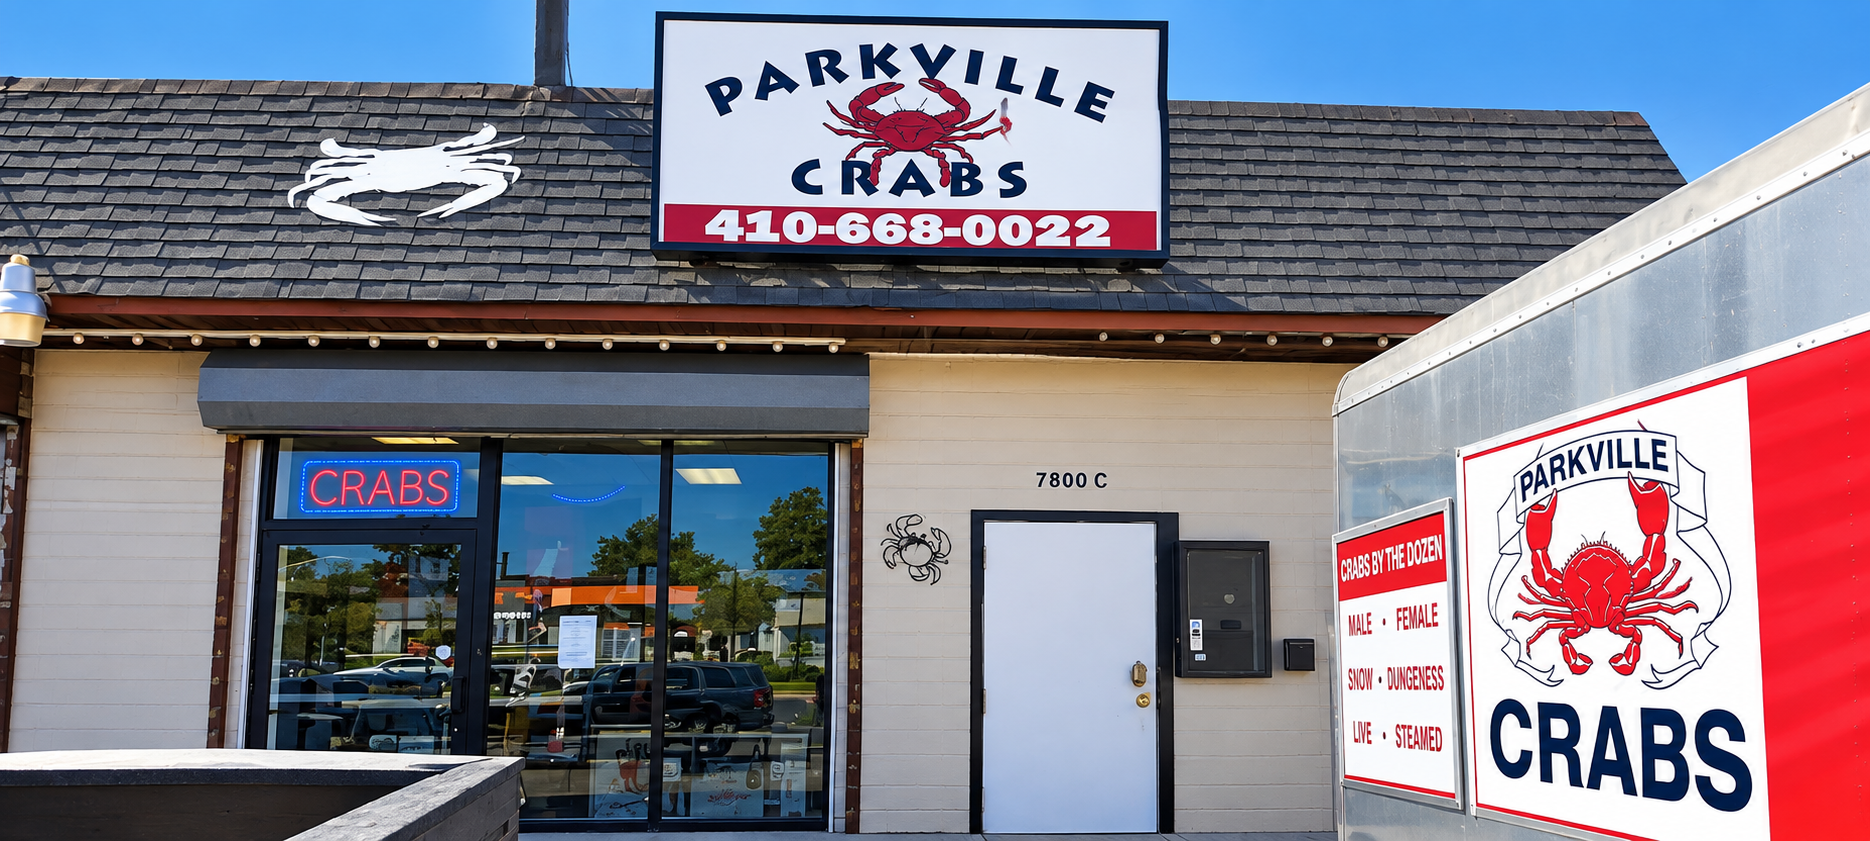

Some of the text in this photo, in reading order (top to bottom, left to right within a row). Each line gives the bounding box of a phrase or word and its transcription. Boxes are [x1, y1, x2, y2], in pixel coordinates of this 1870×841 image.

[704, 42, 1116, 124] PARKVILLE
[791, 158, 1028, 198] CRABS
[704, 208, 1112, 248] 410-668-0022
[309, 469, 450, 506] CRABS
[1036, 472, 1108, 489] 7800 C
[1519, 437, 1669, 503] PARKVILLE
[1340, 534, 1443, 583] CRABS BY THE DOZEN
[1348, 602, 1439, 637] MALE FEMALE
[1348, 665, 1445, 691] SNOW DUNGENESS
[1353, 720, 1443, 752] LIVE STEAMED
[1490, 698, 1753, 813] CRABS
